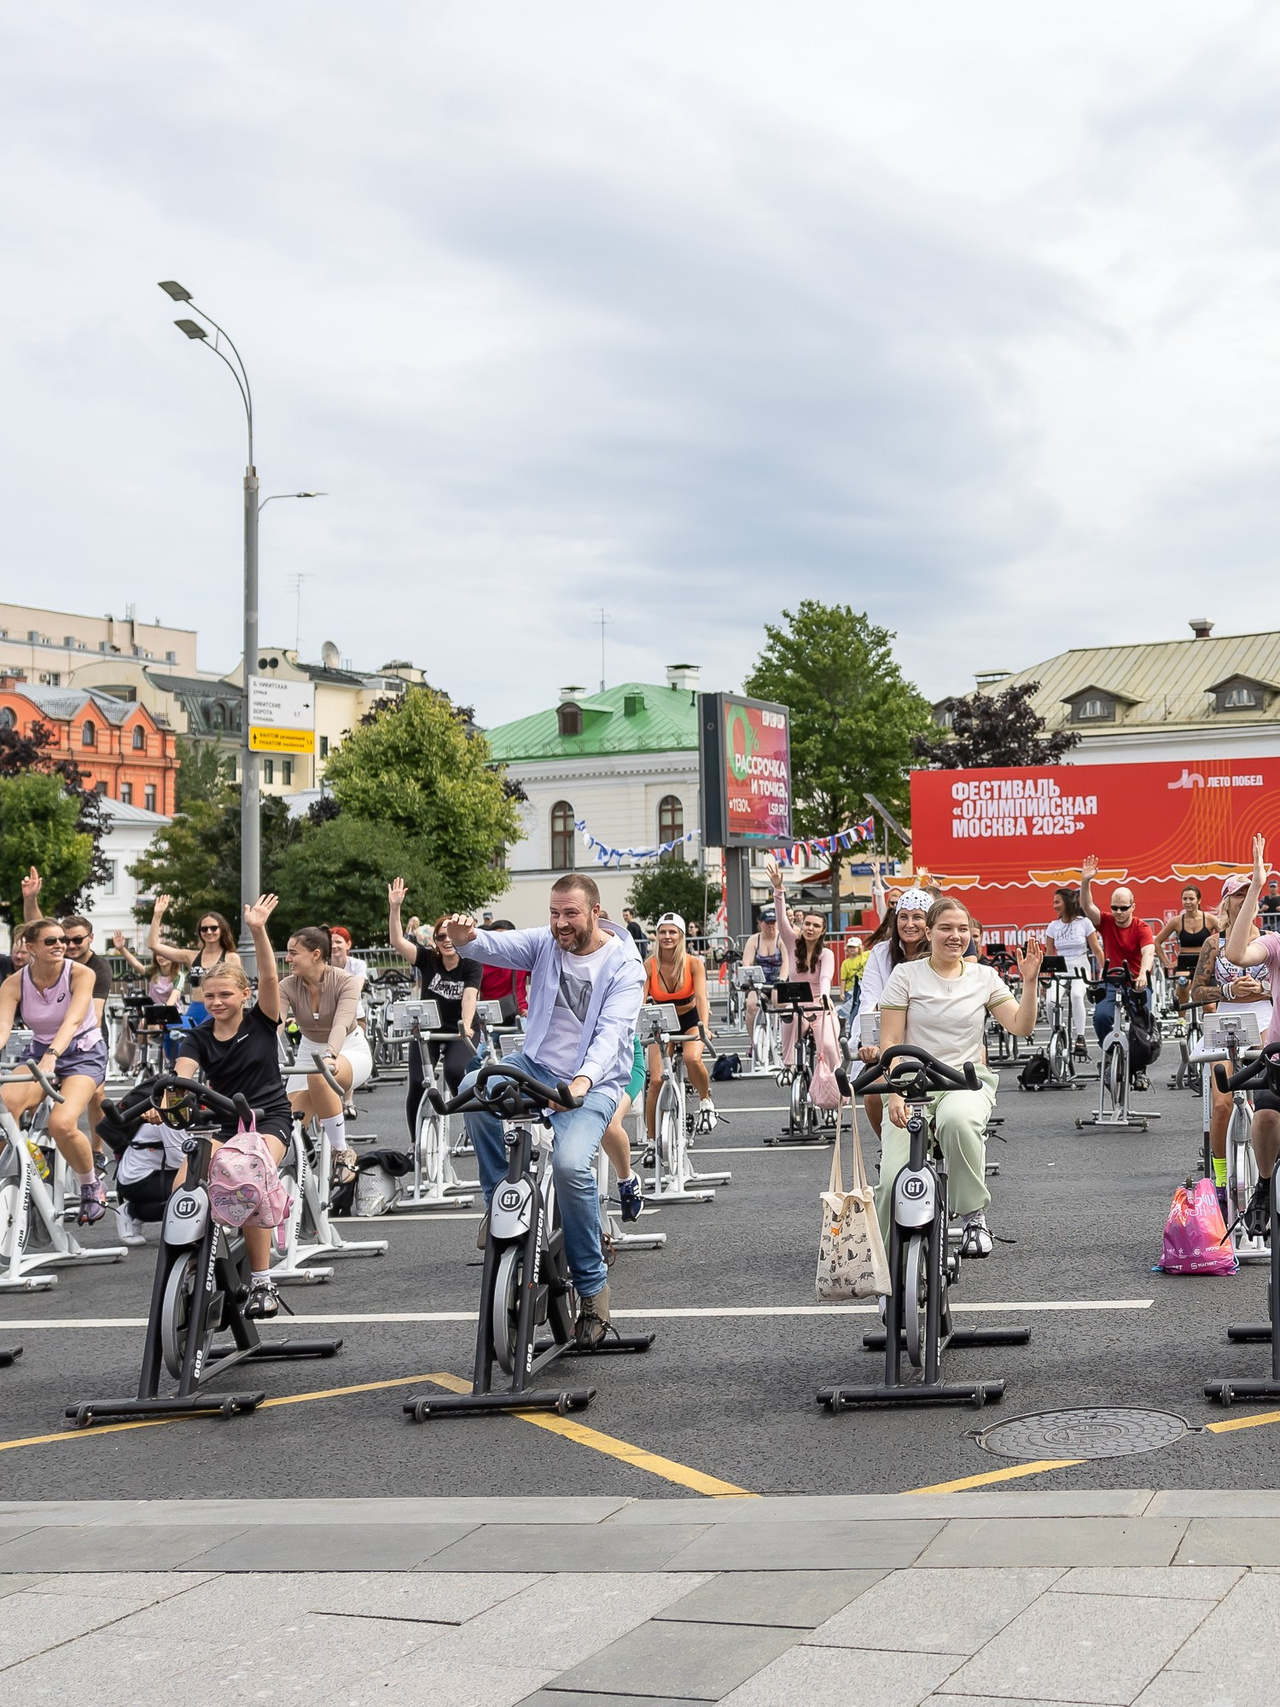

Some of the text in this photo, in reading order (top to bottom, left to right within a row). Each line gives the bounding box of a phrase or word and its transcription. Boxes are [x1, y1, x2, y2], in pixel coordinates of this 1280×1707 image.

[735, 752, 788, 780] РАССРОЧКА
[951, 778, 1061, 801] ФЕСТИВАЛЬ
[1207, 774, 1263, 788] ЛЕТО ПОБЕД
[952, 795, 1098, 819] «ОЛИМПИЙСКАЯ
[952, 815, 1086, 838] МОСКВА 2025»
[907, 1181, 922, 1193] GT
[178, 1200, 194, 1213] GT
[504, 1193, 518, 1206] GT
[533, 1207, 545, 1284] GYMTOUCH
